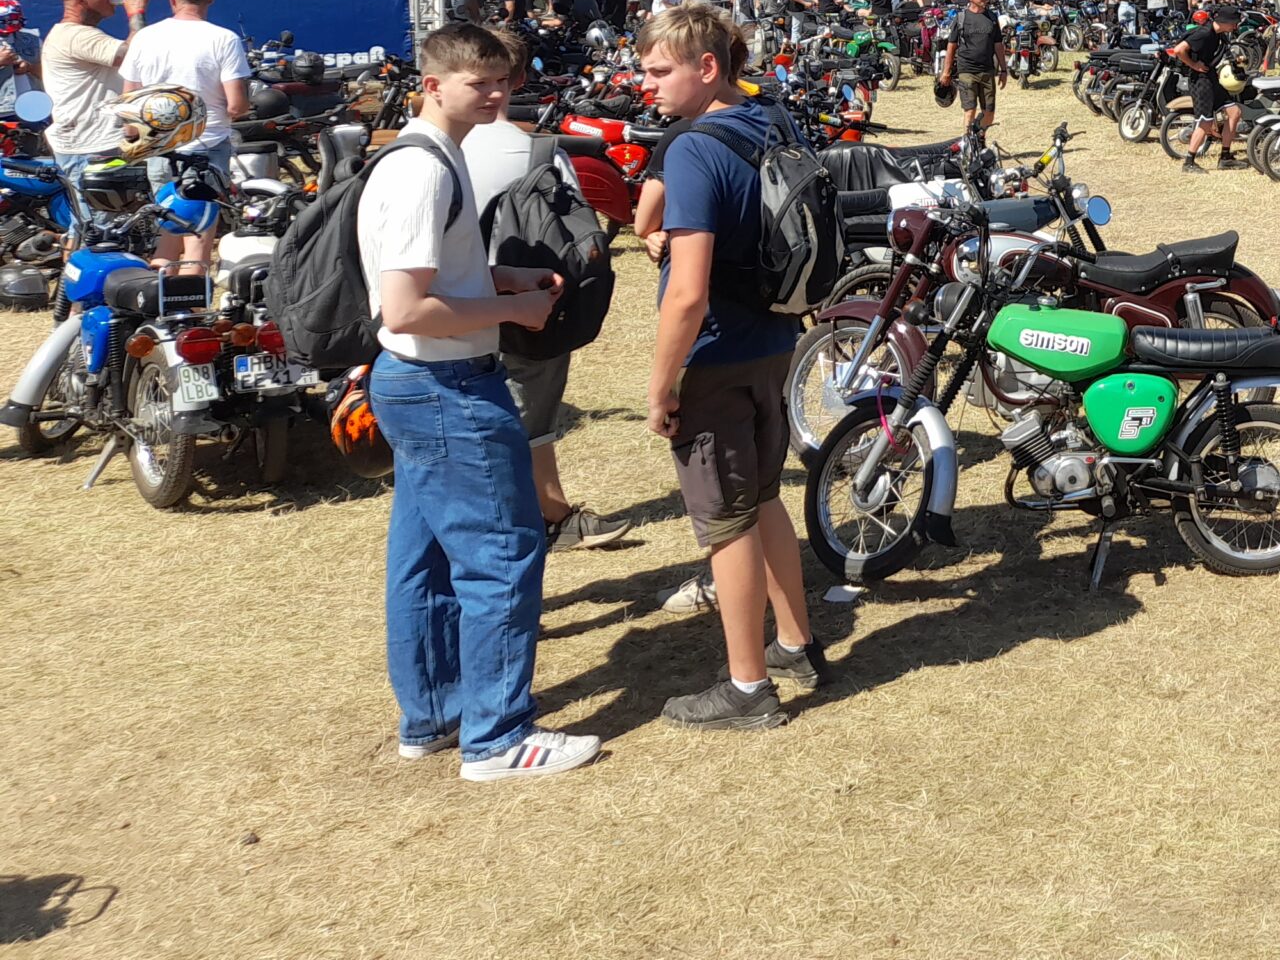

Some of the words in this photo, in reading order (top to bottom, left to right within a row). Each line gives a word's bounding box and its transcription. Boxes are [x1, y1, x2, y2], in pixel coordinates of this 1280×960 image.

[162, 294, 204, 302] simson
[1020, 329, 1090, 356] simson
[250, 354, 288, 371] HBN
[271, 369, 293, 385] 41
[186, 383, 214, 400] LBC
[1141, 417, 1151, 425] 51
